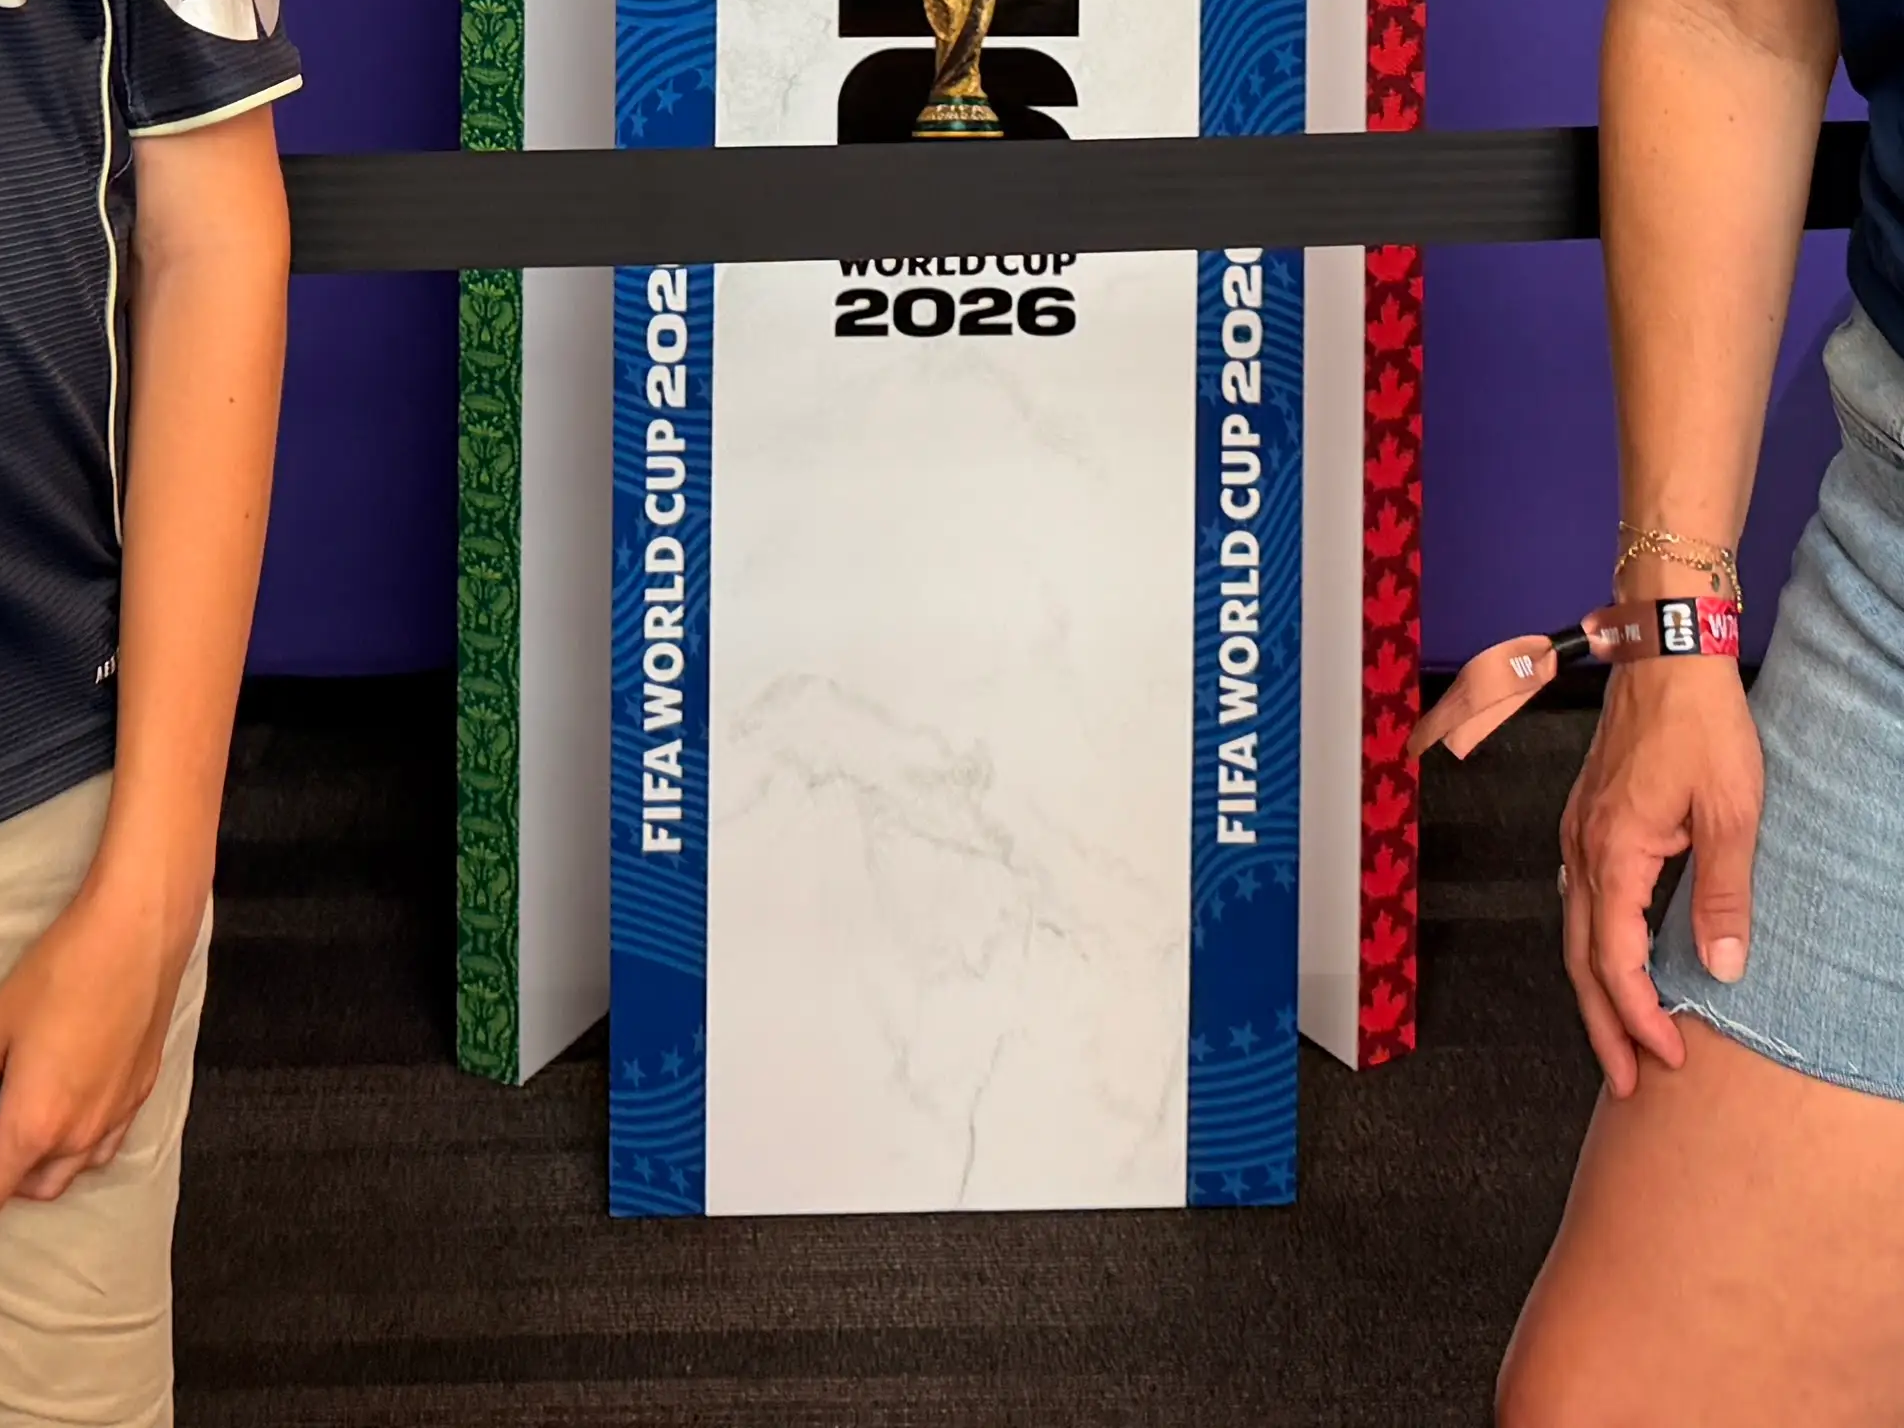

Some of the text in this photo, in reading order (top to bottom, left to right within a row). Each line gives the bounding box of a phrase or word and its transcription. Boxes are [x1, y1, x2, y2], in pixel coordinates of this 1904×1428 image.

[834, 287, 1077, 337] 2026
[839, 253, 1077, 277] WORLD CUP
[1219, 415, 1262, 521] CUP
[642, 263, 688, 853] FIFA WORLD CUP 202
[1217, 529, 1261, 723] WORLD
[1509, 654, 1534, 679] VIP
[1216, 733, 1259, 846] FIFA
